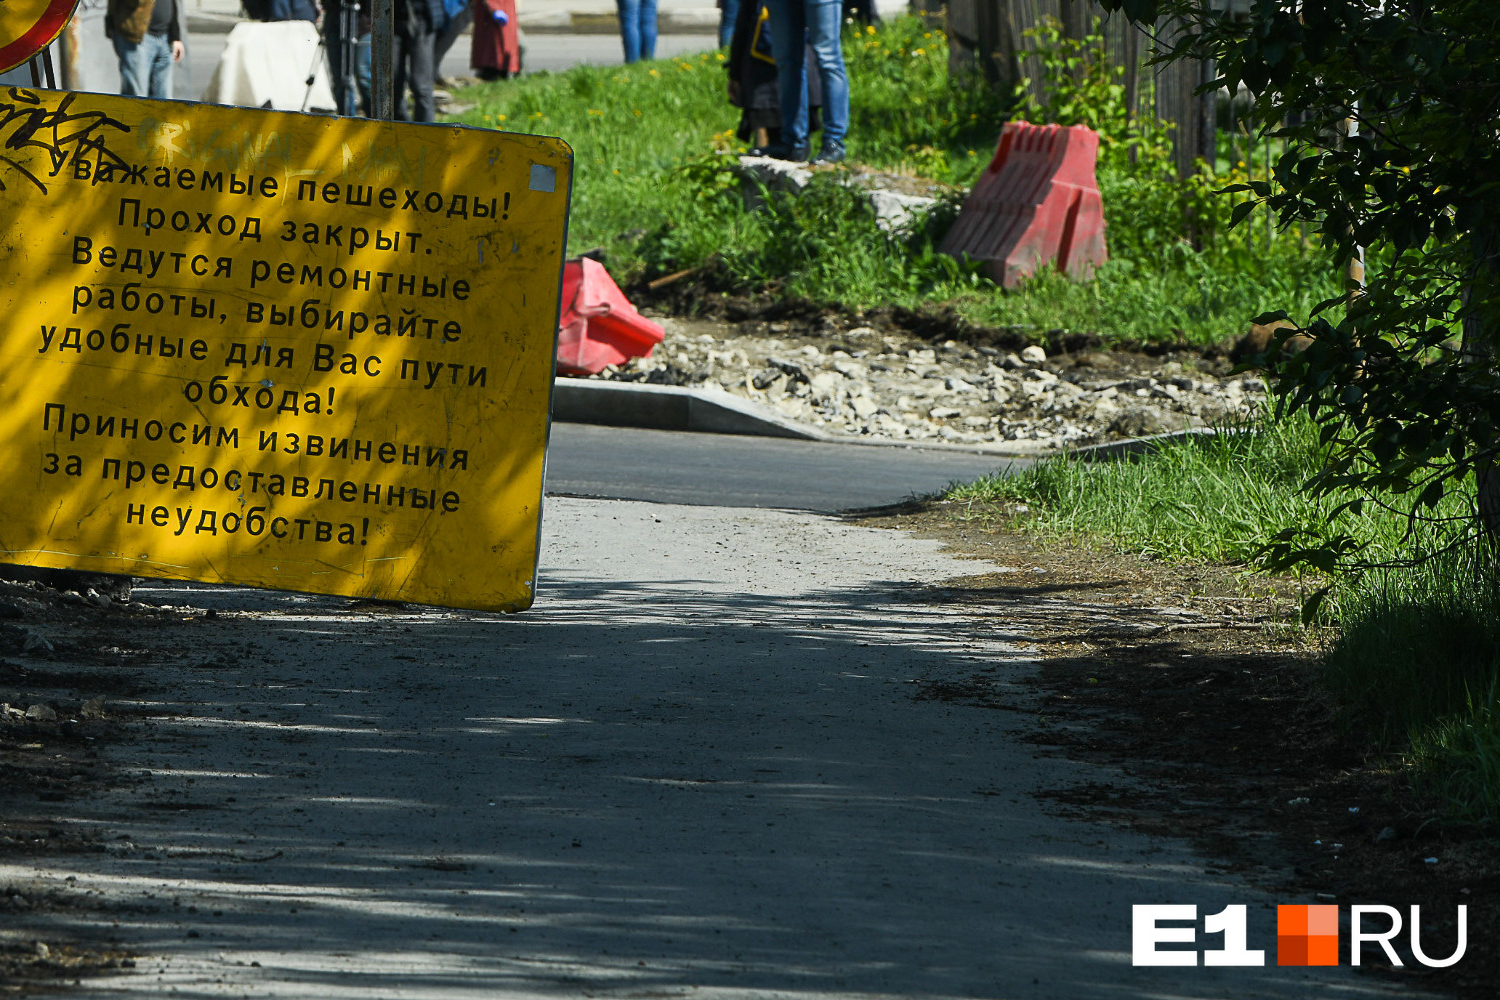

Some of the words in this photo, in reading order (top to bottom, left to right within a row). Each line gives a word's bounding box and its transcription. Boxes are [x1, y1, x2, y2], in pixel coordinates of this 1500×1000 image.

[49, 150, 279, 198] Уважаемые
[297, 180, 511, 221] пешеходы!
[118, 197, 262, 244] Проход
[280, 220, 432, 256] закрыт.
[70, 235, 233, 279] Ведутся
[250, 259, 471, 301] ремонтные
[71, 282, 227, 325] работы,
[246, 298, 462, 345] выбирайте
[38, 323, 209, 362] удобные
[224, 342, 294, 370] для
[313, 342, 382, 378] Вас
[400, 358, 488, 390] пути
[181, 374, 337, 421] обхода!
[43, 402, 239, 449] Приносим
[258, 430, 469, 471] извинения
[43, 452, 83, 477] за
[101, 458, 460, 516] предоставленные
[126, 503, 370, 547] неудобства!
